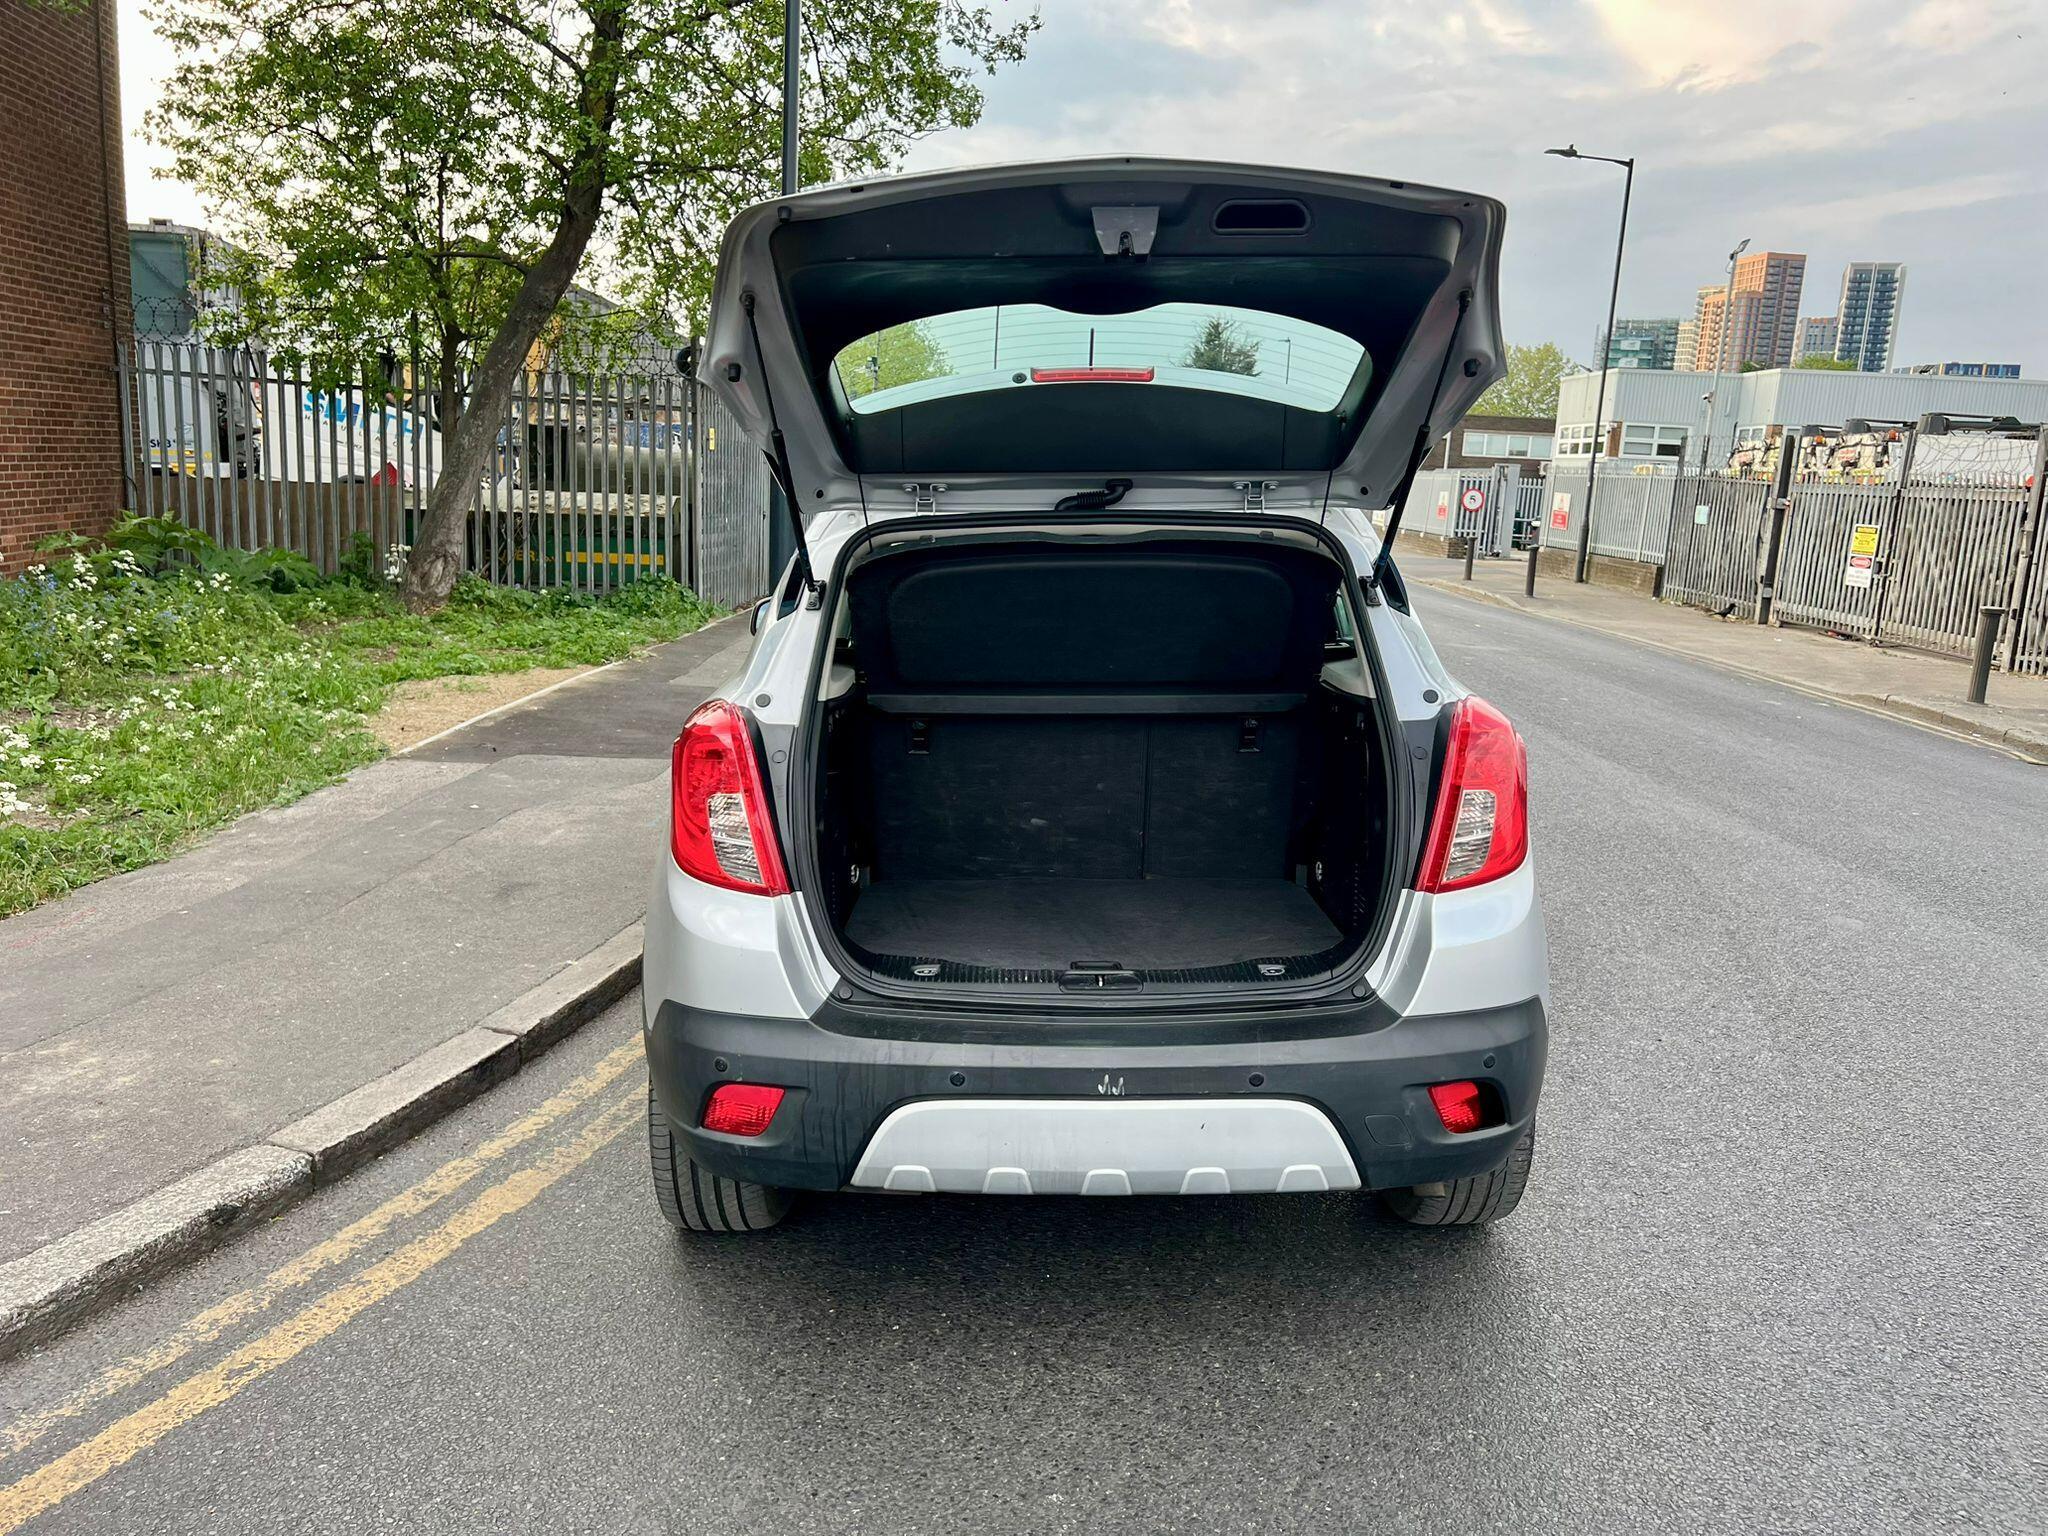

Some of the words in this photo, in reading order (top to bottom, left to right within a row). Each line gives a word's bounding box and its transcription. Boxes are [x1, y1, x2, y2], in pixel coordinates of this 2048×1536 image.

[304, 391, 424, 444] SMTH
[304, 414, 416, 452] HAULAG
[1469, 495, 1476, 503] 5
